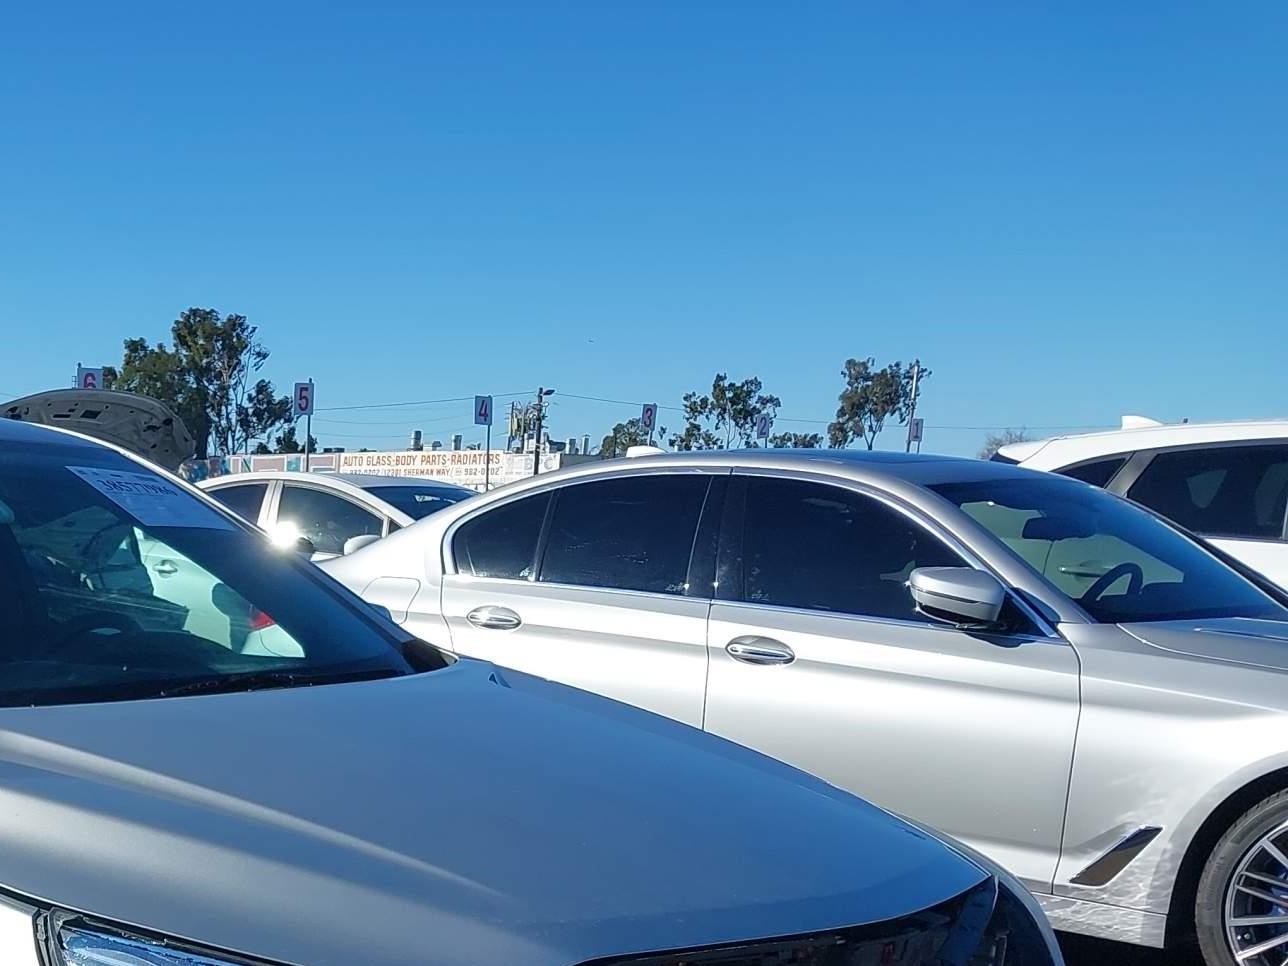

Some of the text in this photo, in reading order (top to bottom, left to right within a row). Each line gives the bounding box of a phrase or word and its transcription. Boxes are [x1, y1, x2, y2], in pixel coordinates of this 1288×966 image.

[83, 372, 97, 389] 6
[298, 386, 310, 412] 5
[478, 399, 489, 423] 4
[643, 407, 653, 428] 3
[759, 416, 768, 436] 2
[912, 422, 921, 440] 1
[343, 455, 364, 467] AUTO
[404, 468, 434, 476] SHERMAN
